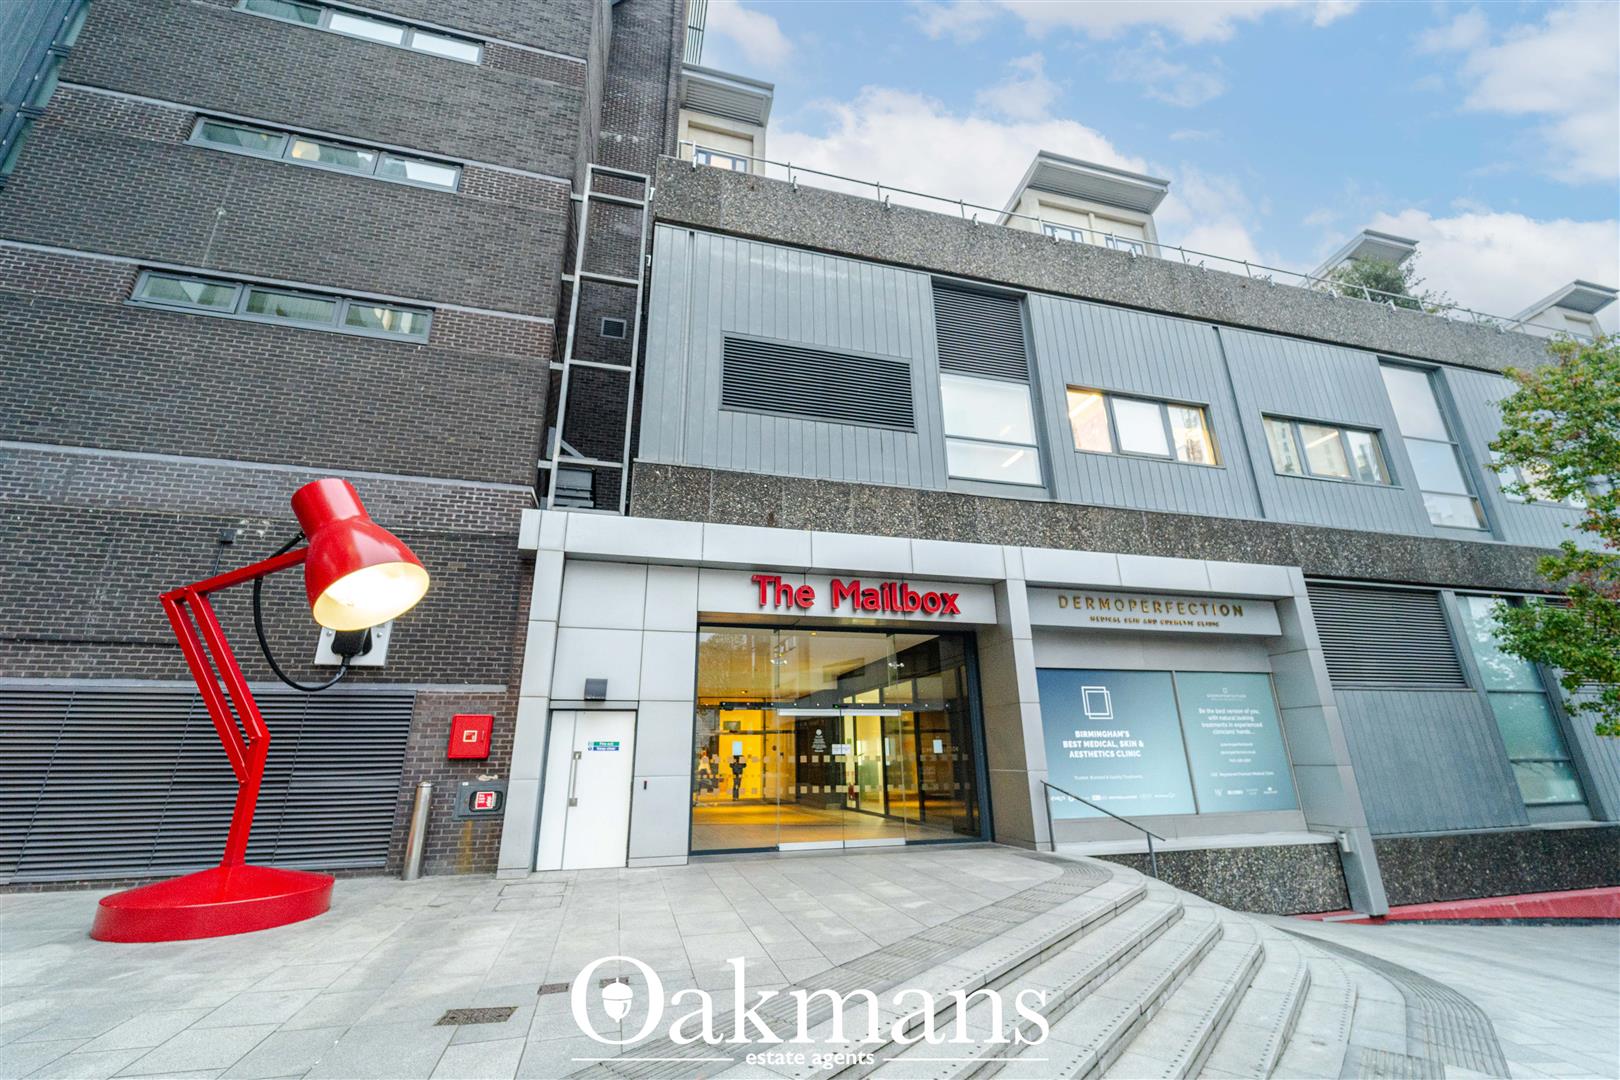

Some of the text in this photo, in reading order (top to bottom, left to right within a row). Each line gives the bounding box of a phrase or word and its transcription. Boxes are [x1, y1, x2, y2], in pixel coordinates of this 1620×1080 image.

[752, 574, 961, 615] The Mailbox
[1057, 595, 1245, 617] DERMOPERFECTION
[1074, 730, 1130, 738] BIRMINGHAM'S
[1062, 740, 1144, 748] BEST MEDICAL, SKIN &
[1069, 750, 1141, 758] AESTHETICS CLINIC
